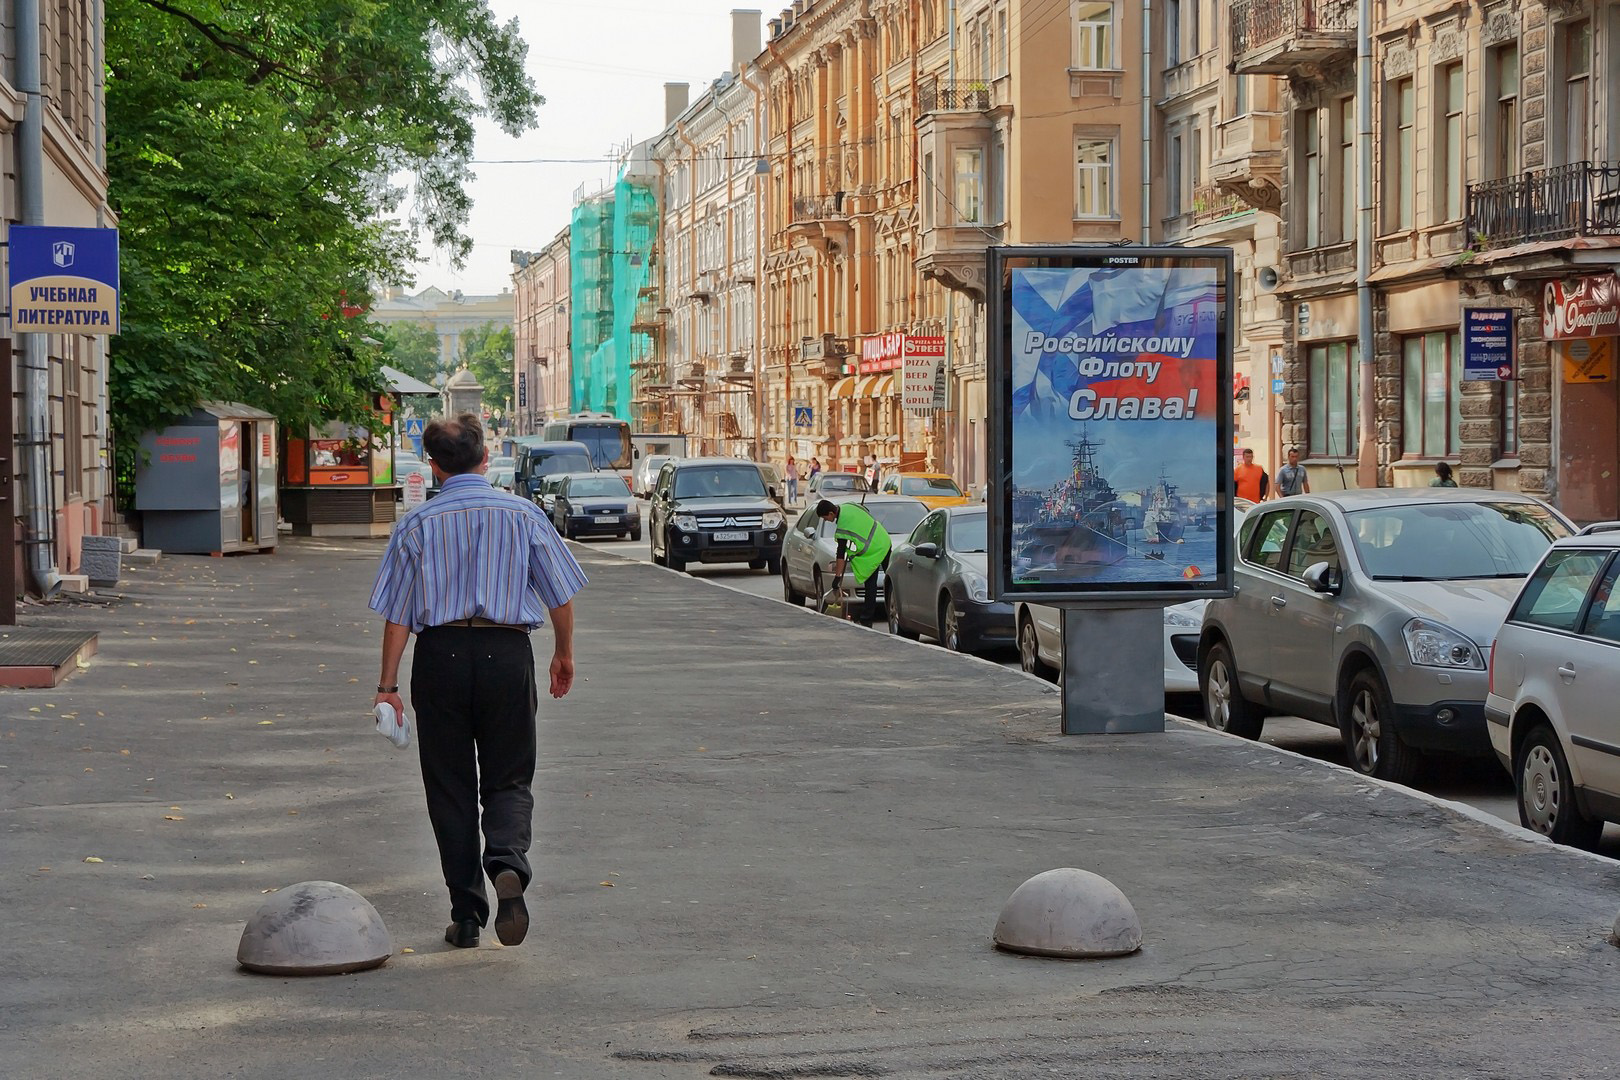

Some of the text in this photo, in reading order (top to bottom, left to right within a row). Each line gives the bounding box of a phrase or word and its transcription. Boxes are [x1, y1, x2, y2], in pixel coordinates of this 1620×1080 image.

[30, 286, 97, 303] УЧЕБНАЯ
[17, 308, 110, 326] ЛИТЕРАТУРА
[905, 340, 944, 353] STREET
[1025, 331, 1195, 358] Российскому
[905, 359, 931, 367] PIZZA
[1078, 356, 1161, 384] Флоту
[905, 384, 934, 392] STEAK
[905, 396, 931, 404] GRILL
[1068, 388, 1199, 420] Слава!
